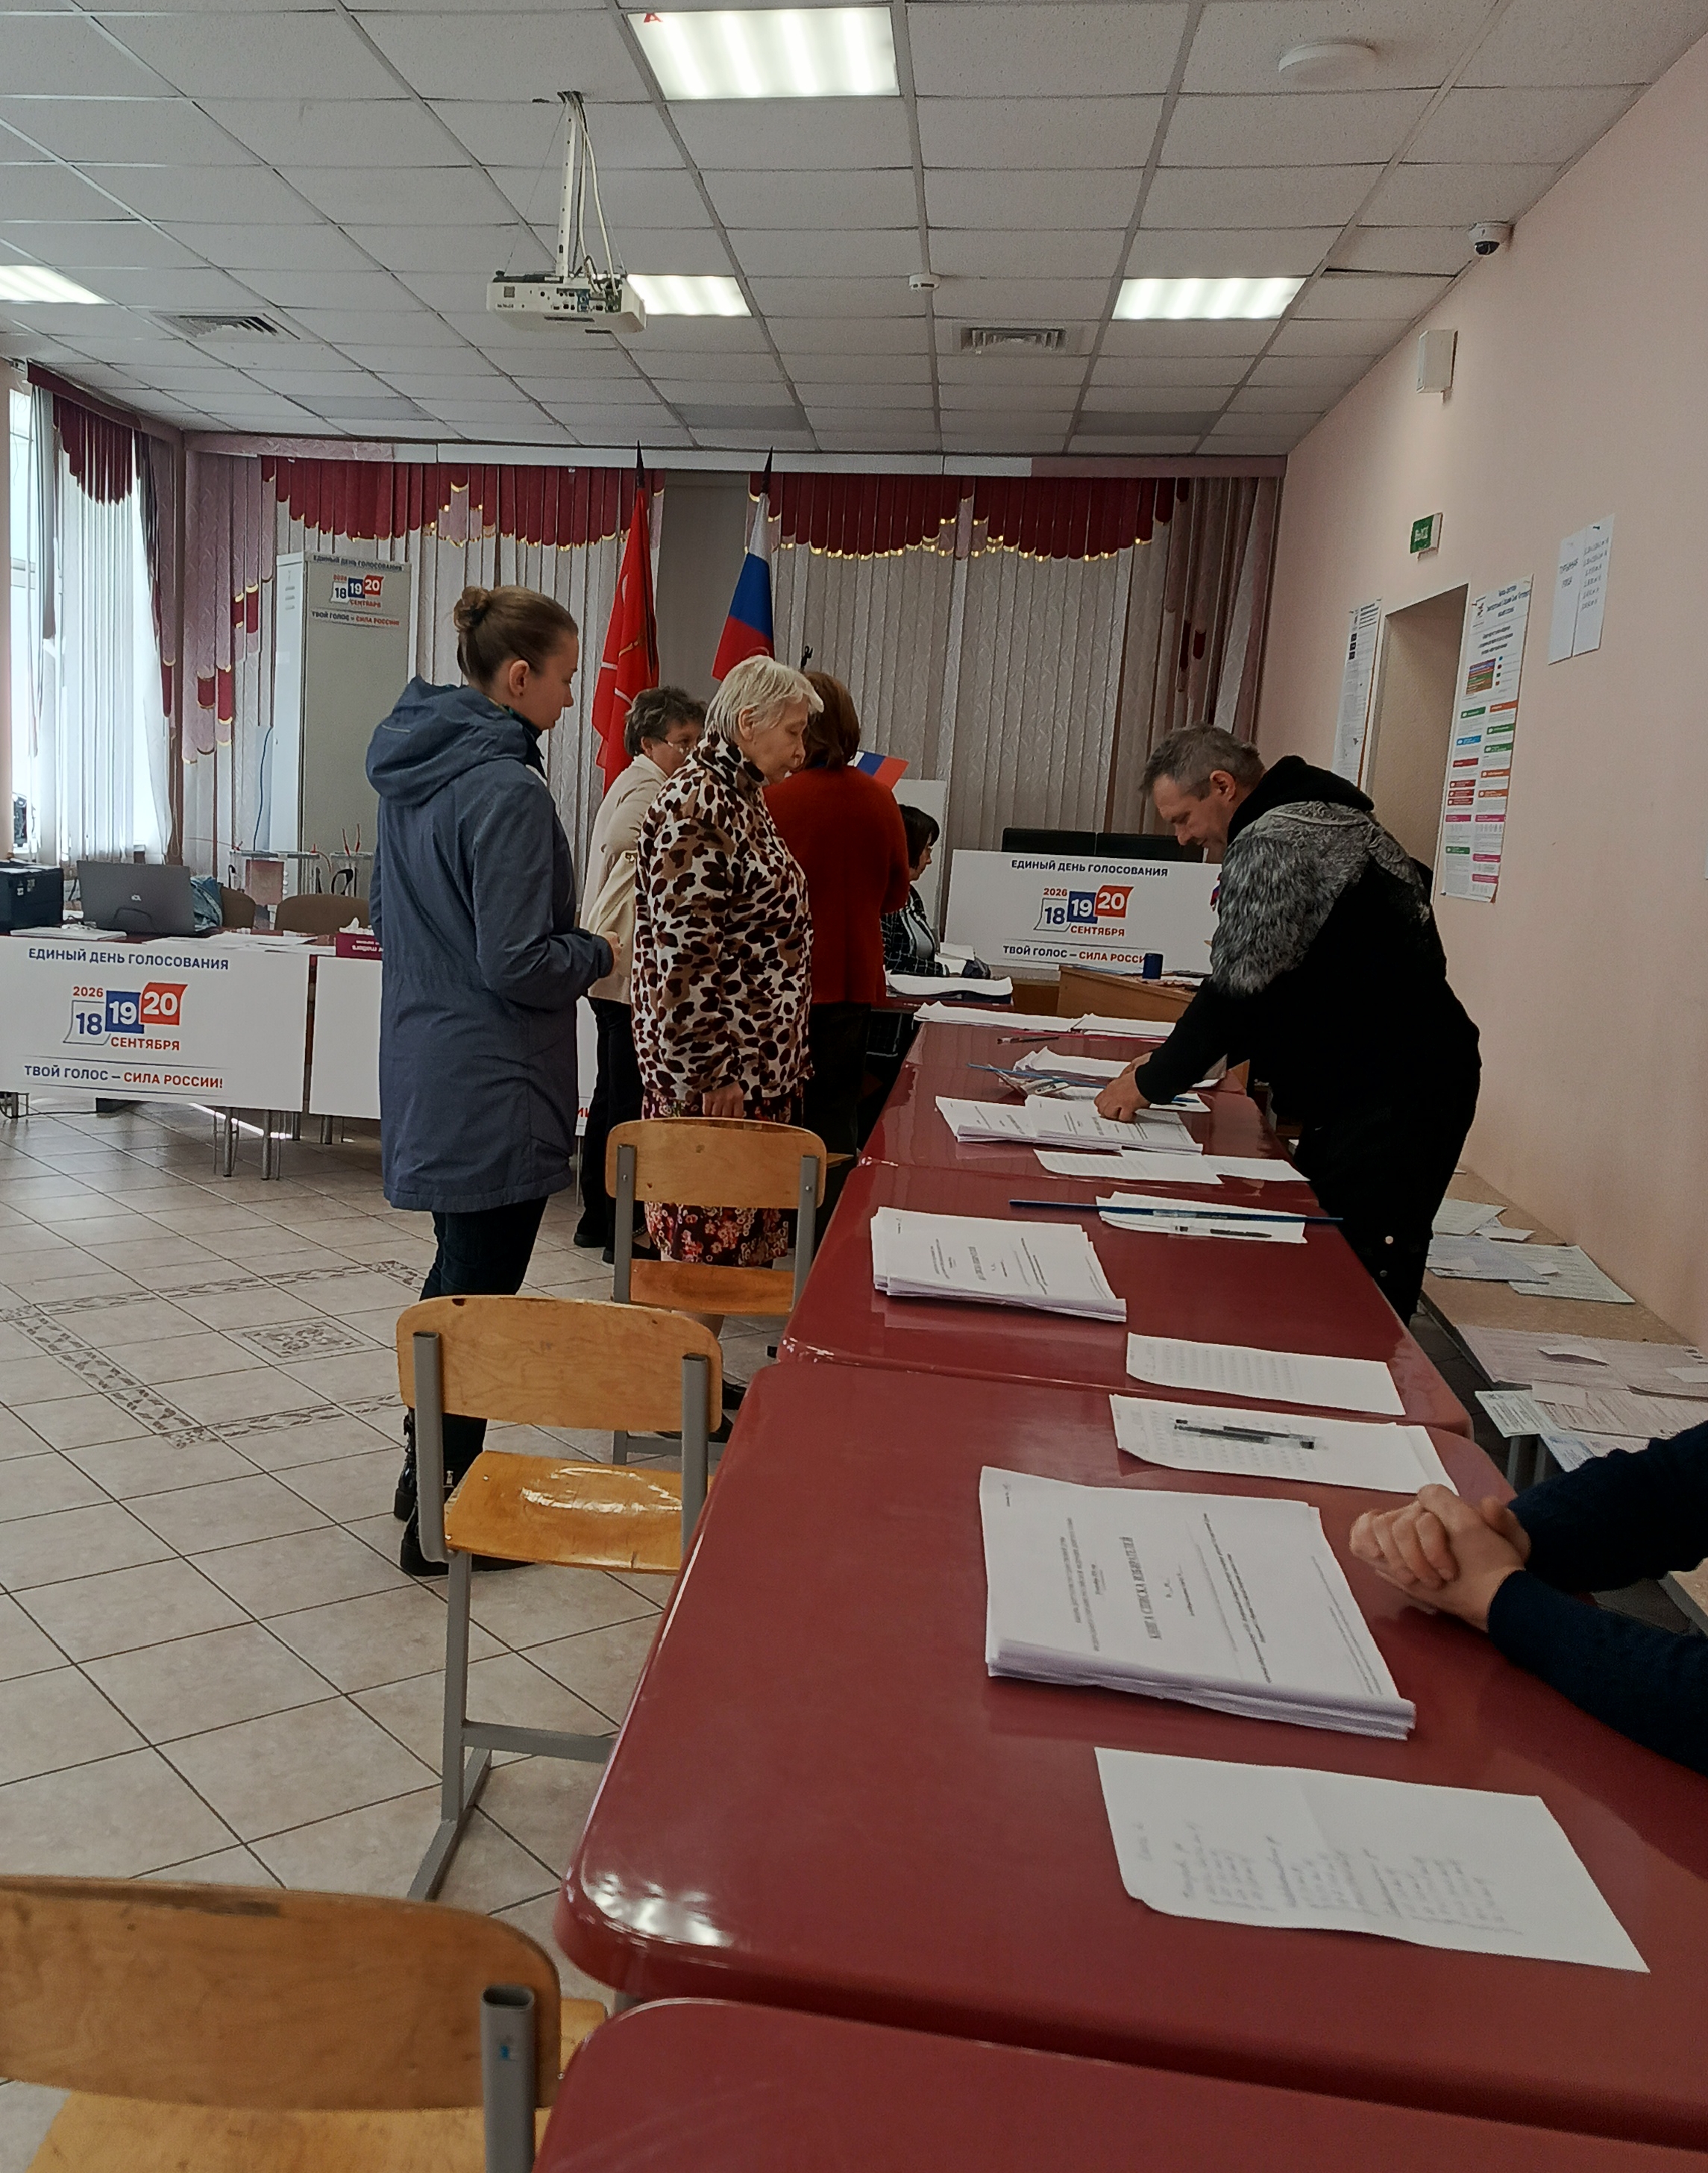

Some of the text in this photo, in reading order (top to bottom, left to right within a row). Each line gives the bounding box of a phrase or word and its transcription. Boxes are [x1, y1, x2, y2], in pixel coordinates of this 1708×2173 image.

[335, 587, 347, 599] 18
[350, 583, 362, 595] 19
[365, 579, 380, 592] 20
[330, 612, 349, 621] ГОЛОС
[356, 615, 372, 624] СИЛА
[1011, 859, 1168, 877] ЕДИНЫЙ ДЕНЬ ГОЛОСОВАНИЯ
[1043, 888, 1067, 897] 2026
[1071, 899, 1093, 917] 19
[1097, 893, 1125, 909] 20
[1044, 907, 1065, 924] 18
[1070, 926, 1125, 937] СЕНТЯБРЯ
[28, 948, 229, 970] ЕДИНЫЙ ДЕНЬ ГОЛОСОВАНИЯ
[1003, 945, 1031, 956] ТВОЙ
[1033, 947, 1067, 958] ГОЛОС
[1079, 951, 1108, 961] СИЛА
[1111, 953, 1145, 964] РОССИ
[73, 986, 104, 998] 2026
[143, 992, 178, 1016] 20
[109, 1001, 136, 1025] 19
[76, 1012, 103, 1035] 18
[110, 1037, 180, 1050] СЕНТЯБРЯ
[24, 1064, 60, 1077] ТВОЙ
[64, 1068, 108, 1081] ГОЛОС
[124, 1072, 160, 1084] СИЛА
[164, 1075, 223, 1088] РОССИИ!
